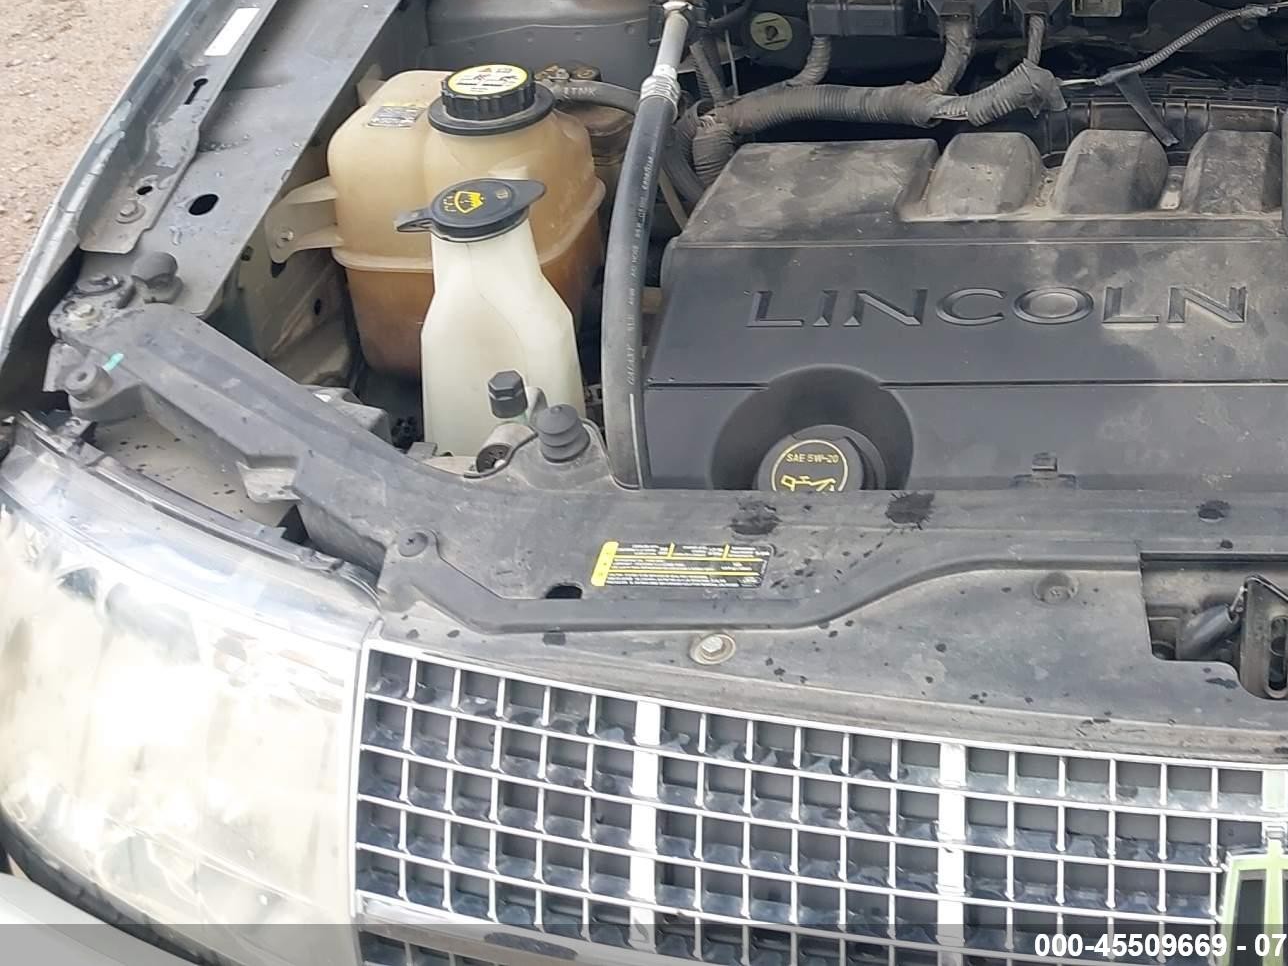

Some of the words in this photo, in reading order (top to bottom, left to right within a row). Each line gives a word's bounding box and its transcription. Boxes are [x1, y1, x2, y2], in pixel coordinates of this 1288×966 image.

[744, 286, 1248, 328] LINCOLN
[785, 452, 806, 463] SAE
[807, 453, 839, 464] 5W-20
